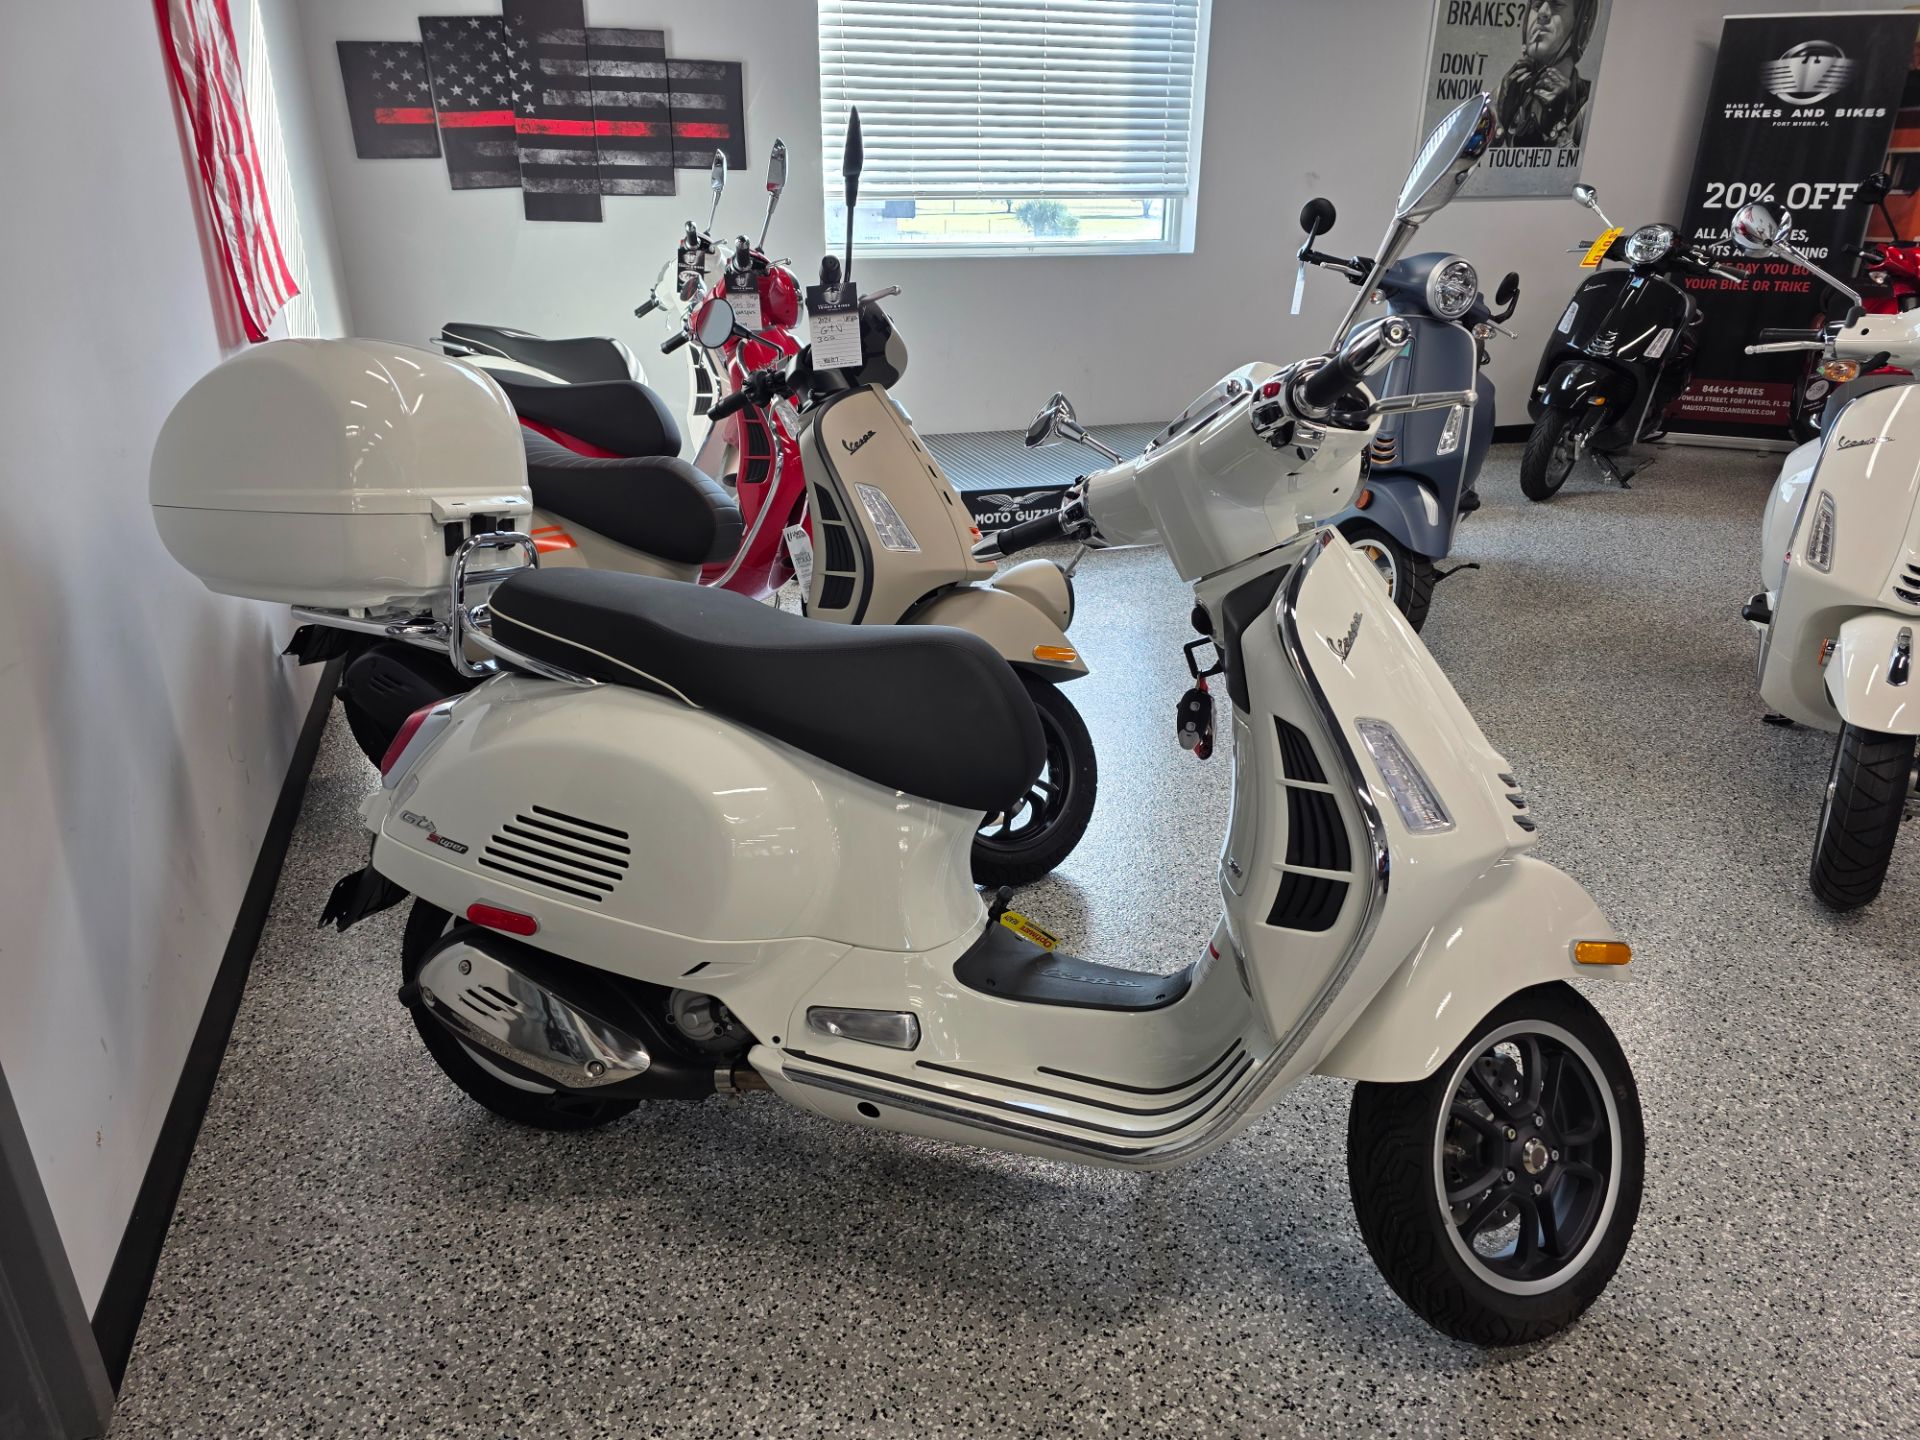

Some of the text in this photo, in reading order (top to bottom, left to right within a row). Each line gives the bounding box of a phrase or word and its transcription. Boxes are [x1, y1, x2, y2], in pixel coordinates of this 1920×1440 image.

[1447, 0, 1526, 27] BRAKES?
[1440, 52, 1488, 76] DON'T
[1436, 78, 1484, 100] KNOW
[1724, 108, 1887, 119] TRIKES AND BIKES
[1488, 149, 1580, 168] TOUCHED EM
[1703, 182, 1860, 210] 20% OFF
[1694, 227, 1717, 239] ALL
[1736, 262, 1760, 275] DAY
[1763, 263, 1790, 276] YOU
[1792, 264, 1821, 276] BU
[1685, 278, 1812, 293] YOUR BIKE OR TRIKE
[1702, 384, 1764, 396] 844-64-BIKES
[841, 430, 877, 456] Vespa
[975, 511, 1011, 524] MOTO
